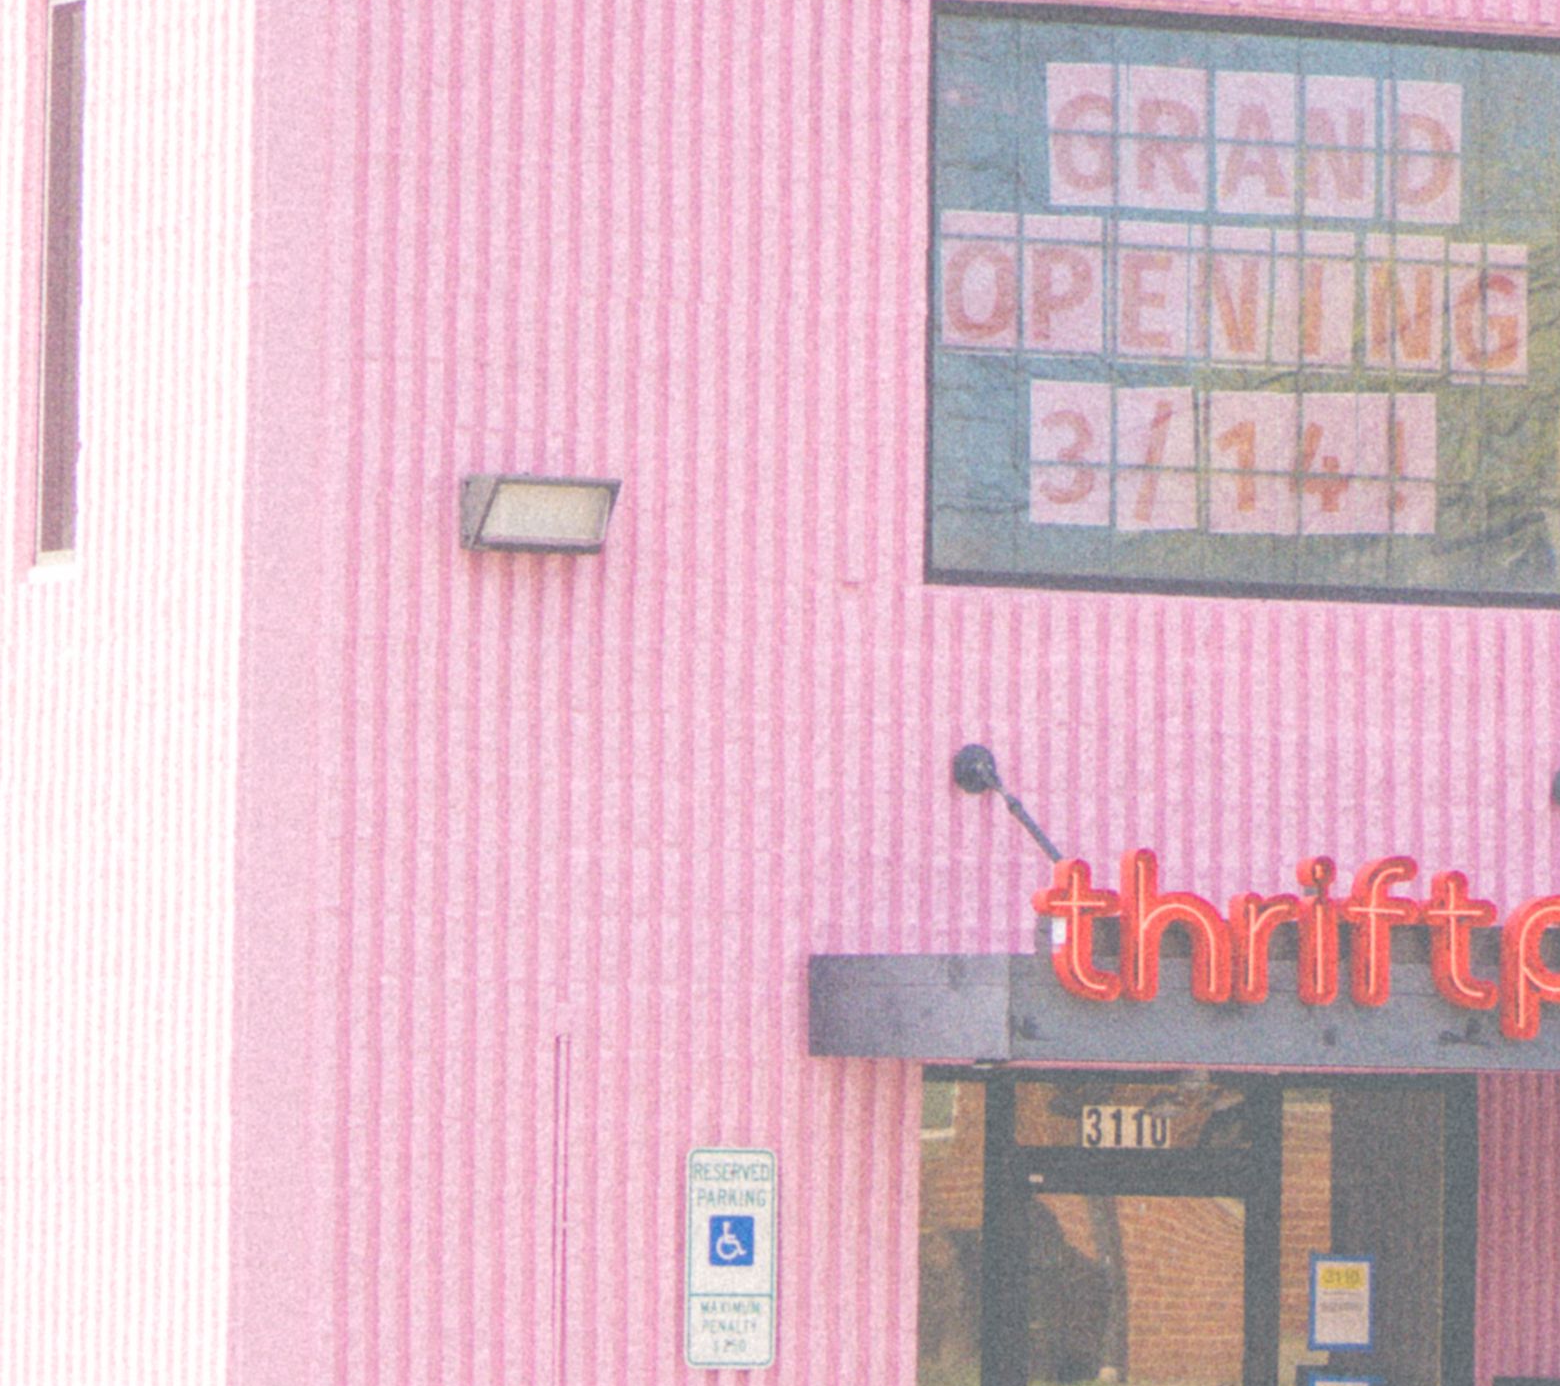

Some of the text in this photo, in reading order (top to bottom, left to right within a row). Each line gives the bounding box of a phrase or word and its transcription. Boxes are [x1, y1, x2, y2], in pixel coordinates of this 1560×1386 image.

[1054, 92, 1455, 206] GRAND
[941, 244, 1523, 369] OPENING
[1039, 399, 1408, 523] 3/14!
[1086, 1108, 1167, 1145] 3110
[693, 1163, 769, 1182] RESERVED
[697, 1188, 767, 1207] PARKING
[700, 1301, 762, 1315] MAXIMUM
[701, 1318, 757, 1333] PENALTY
